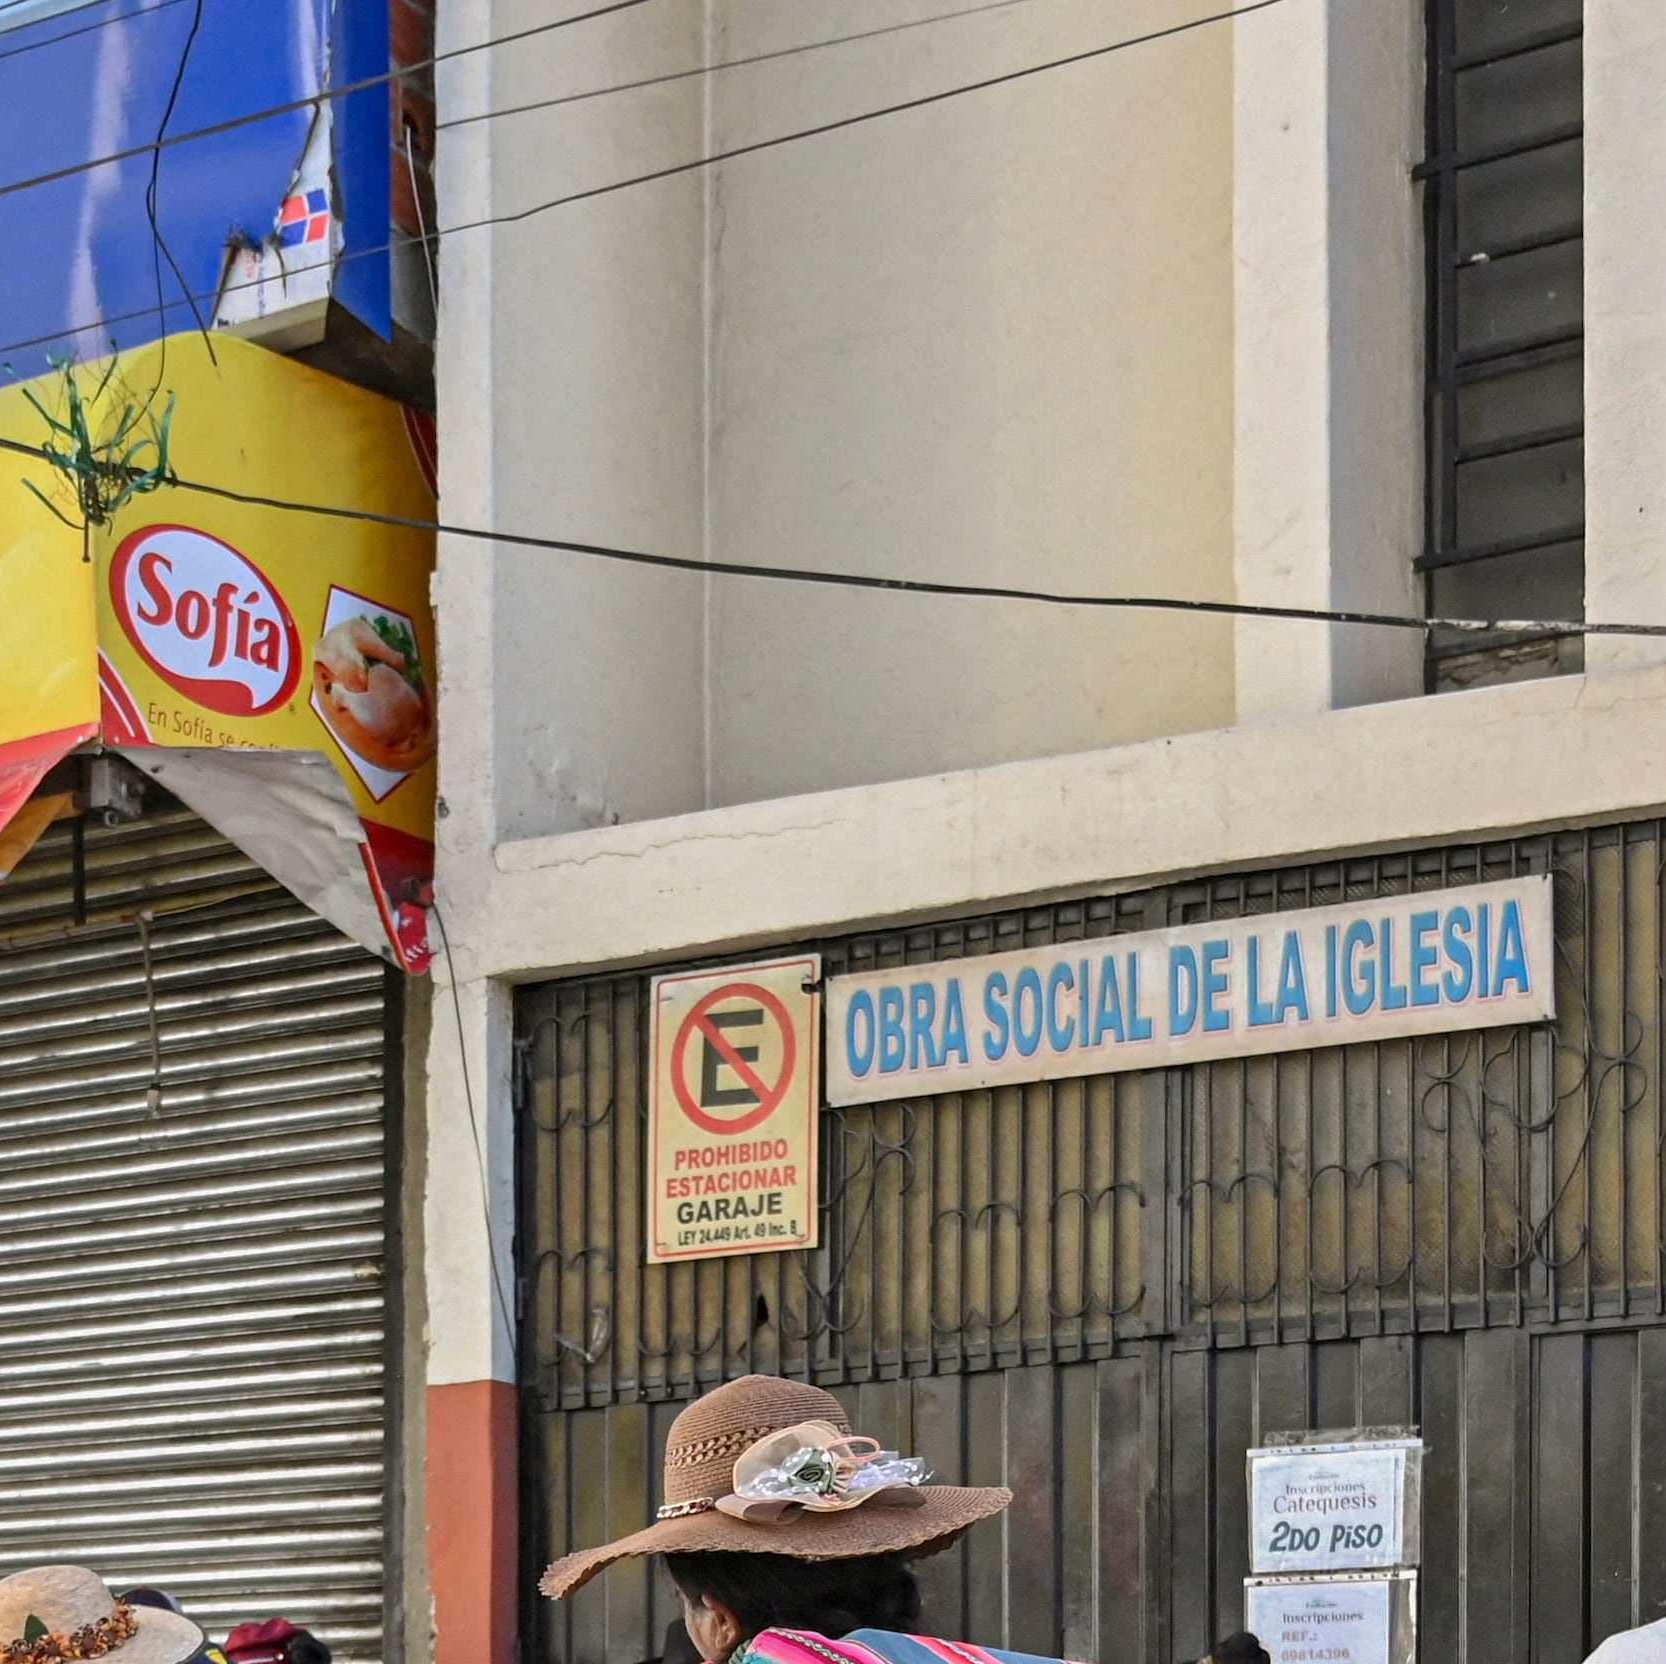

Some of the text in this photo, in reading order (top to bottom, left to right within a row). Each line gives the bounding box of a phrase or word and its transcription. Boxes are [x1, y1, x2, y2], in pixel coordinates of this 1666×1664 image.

[137, 552, 282, 673] Sofía
[148, 703, 167, 728] En
[173, 712, 214, 744] Sofía
[845, 899, 1530, 1079] OBRA SOCIAL DE LA IGLESIA
[674, 1138, 788, 1171] PROHIBIDO
[666, 1165, 797, 1199] ESTACIONAR
[676, 1192, 783, 1225] GARAJE
[677, 1229, 696, 1246] LEY
[733, 1225, 751, 1241] Art.
[754, 1222, 766, 1237] 49
[768, 1221, 787, 1236] Inc.
[1273, 1492, 1377, 1515] Catequesis
[1285, 1481, 1366, 1496] Inscripciones
[1268, 1520, 1321, 1553] 2DO
[1282, 1611, 1364, 1625] Inscripciones
